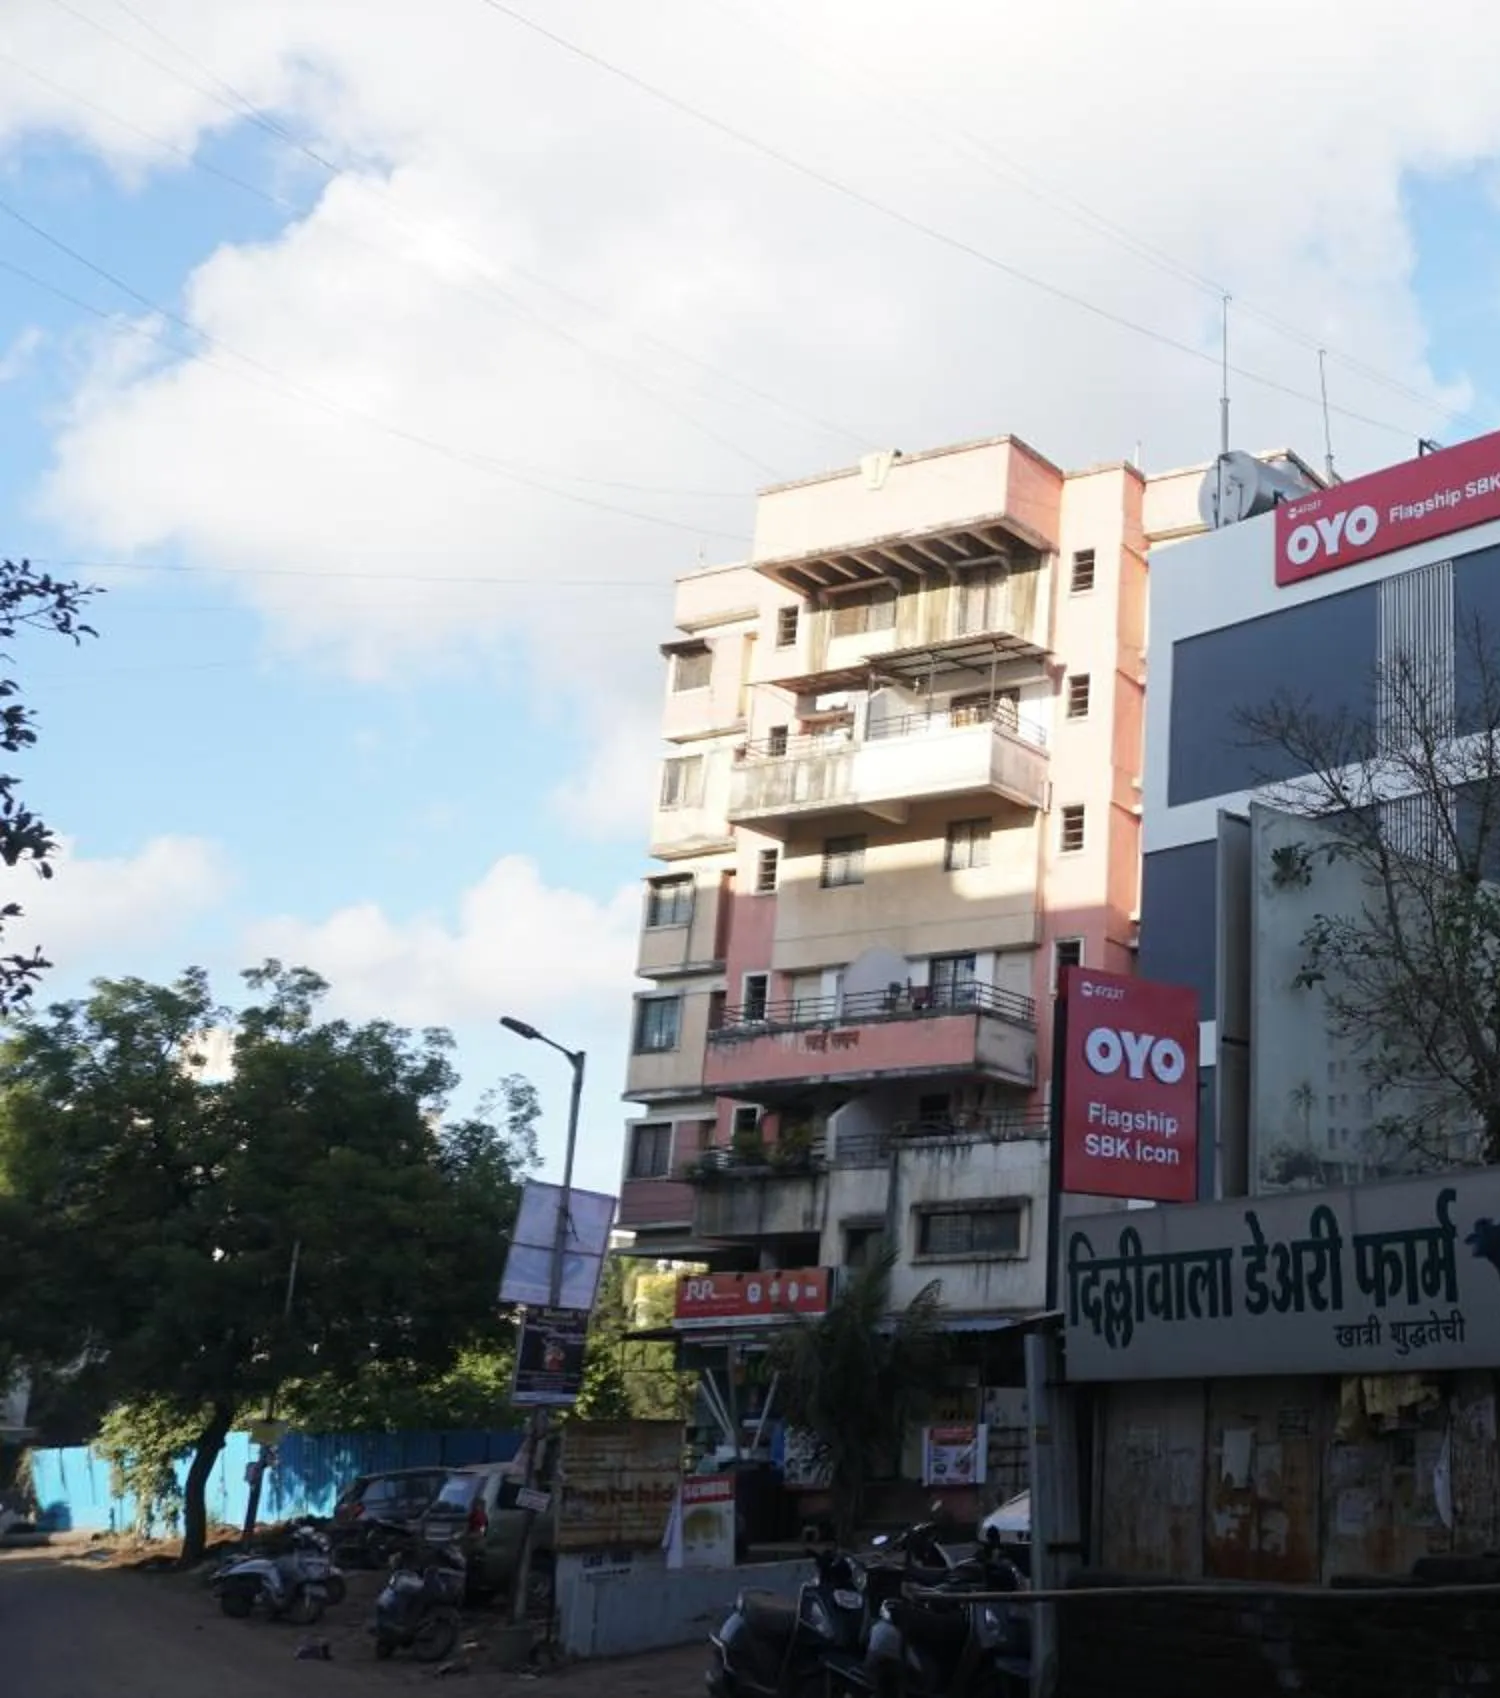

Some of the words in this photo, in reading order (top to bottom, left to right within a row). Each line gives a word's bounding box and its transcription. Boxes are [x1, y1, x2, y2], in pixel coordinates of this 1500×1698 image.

[1389, 488, 1462, 524] Flagship
[1286, 504, 1379, 566] OYO
[1084, 1026, 1186, 1084] OYO
[1087, 1102, 1179, 1139] Flagship
[1084, 1132, 1131, 1161] SBK
[1135, 1141, 1181, 1166] Icon
[1241, 1204, 1344, 1316] डेअरी
[1353, 1187, 1459, 1308] फार्म
[1333, 1312, 1382, 1348] खात्री
[1389, 1309, 1465, 1356] शुद्धतेची
